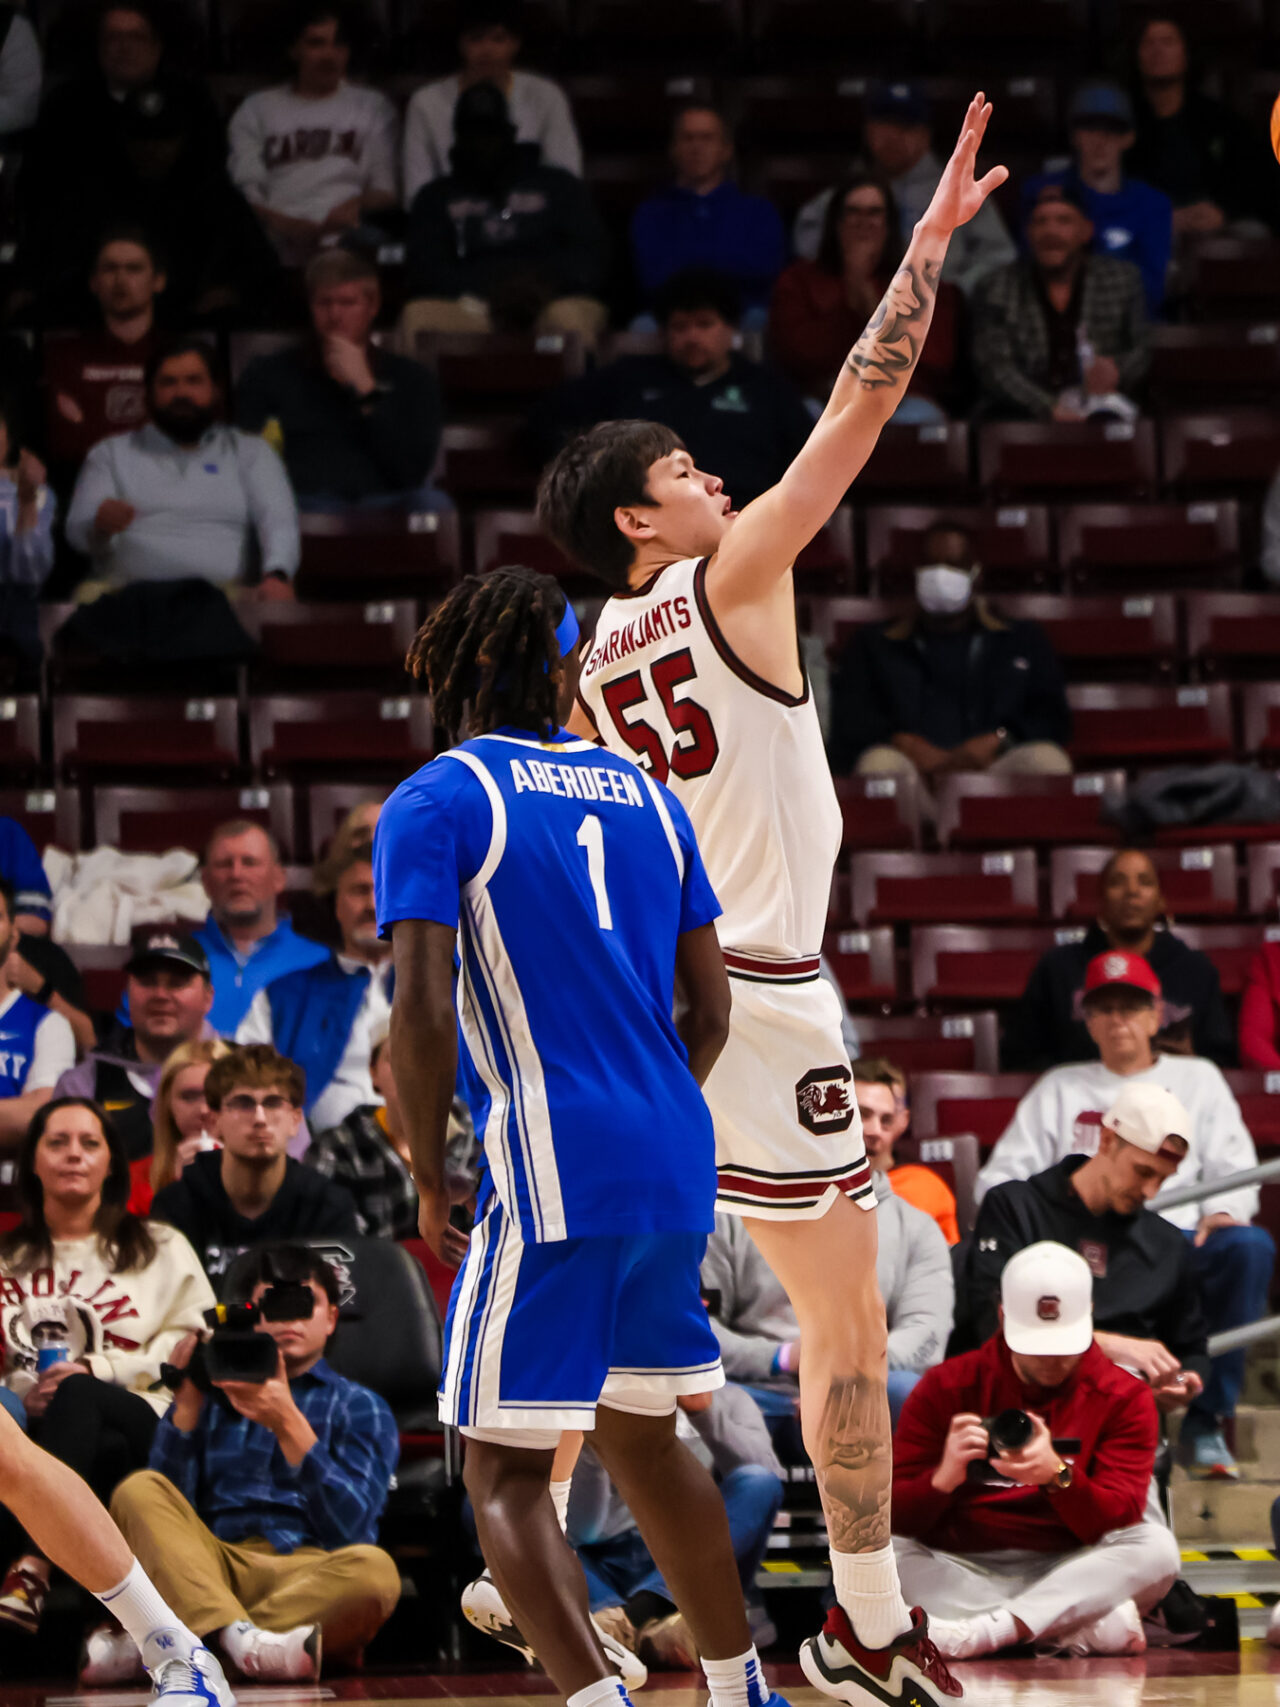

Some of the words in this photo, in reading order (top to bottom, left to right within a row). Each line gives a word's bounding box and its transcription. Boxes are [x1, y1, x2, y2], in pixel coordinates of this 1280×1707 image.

[585, 595, 692, 677] SHARAVJAMTS
[601, 647, 720, 786] 55
[509, 758, 644, 808] ABERDEEN
[576, 813, 613, 931] 1
